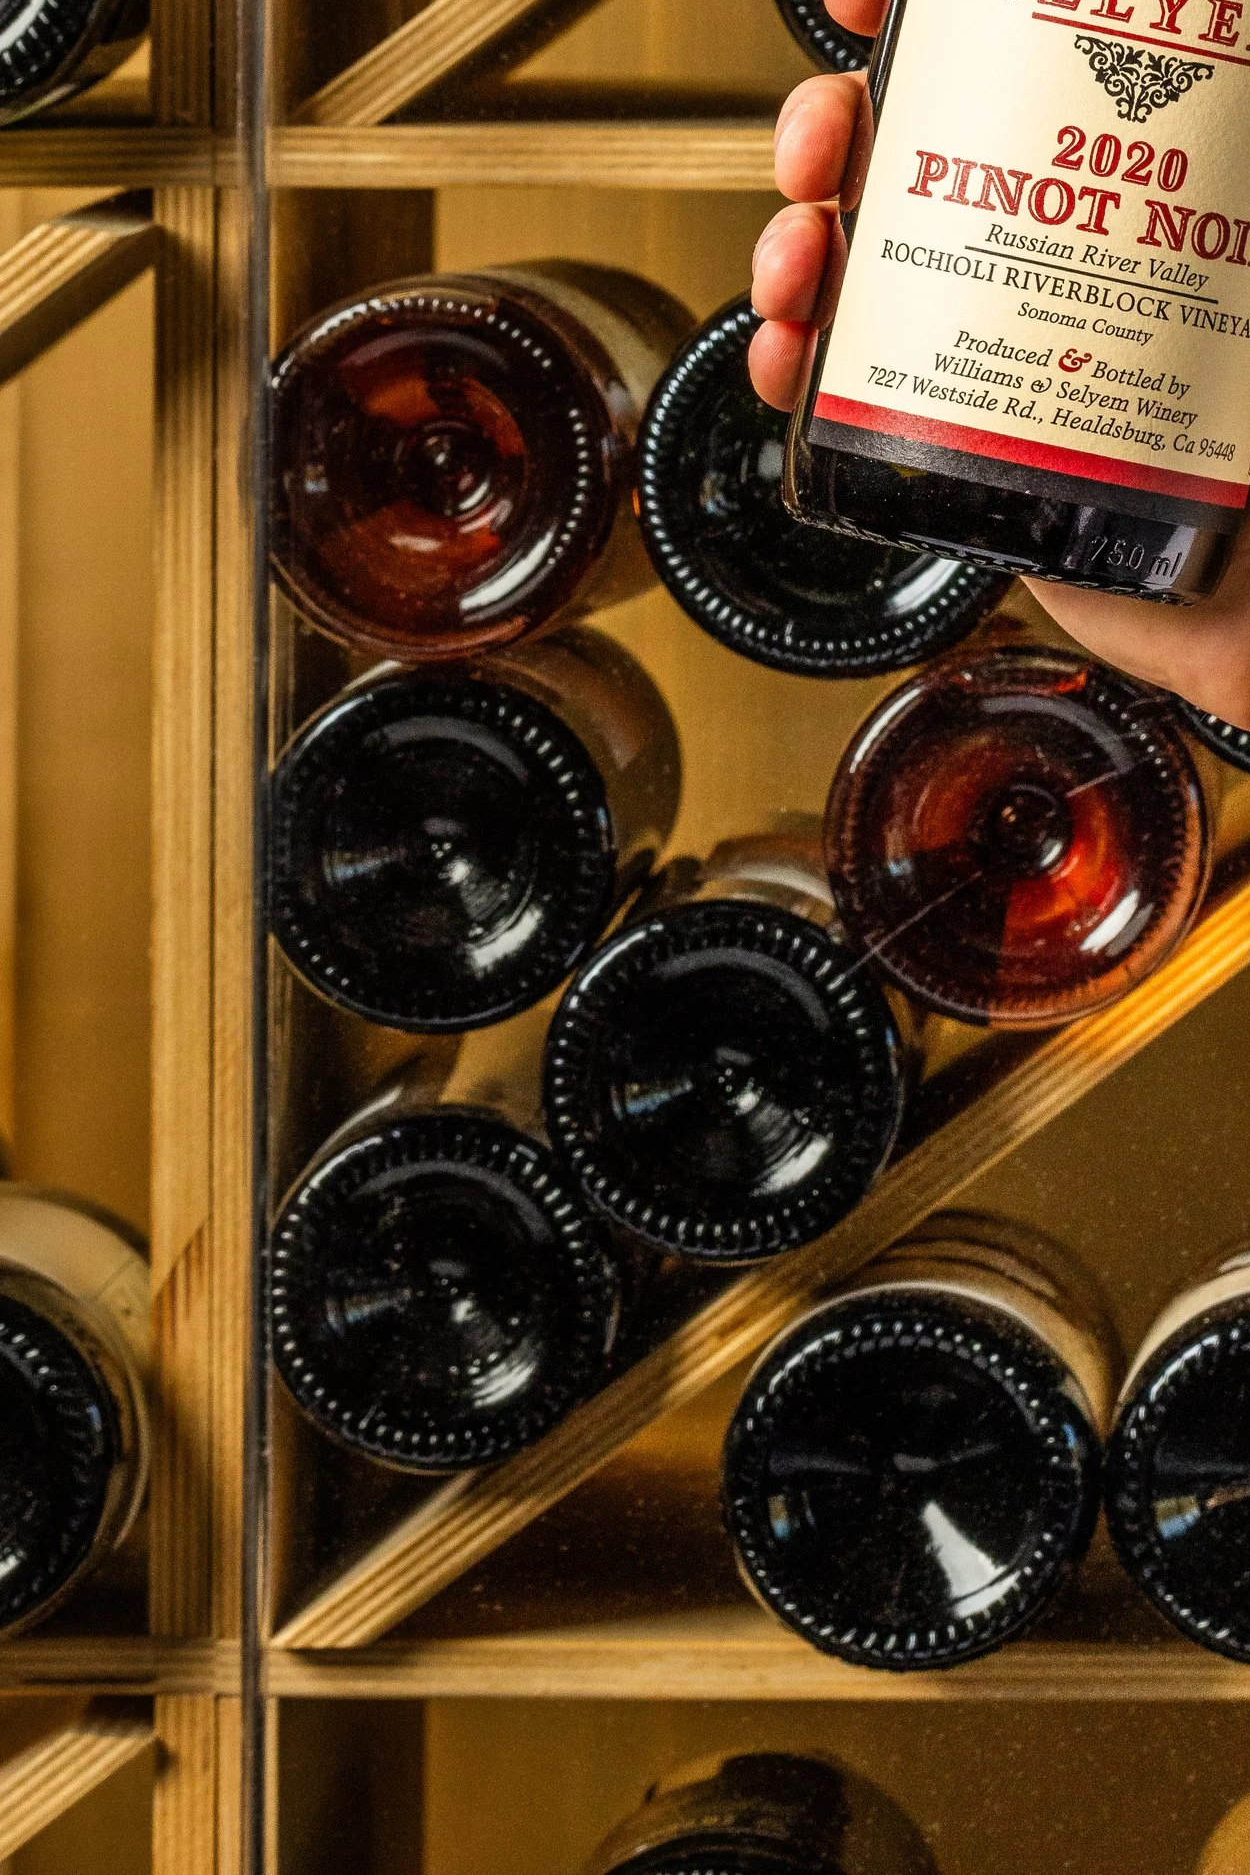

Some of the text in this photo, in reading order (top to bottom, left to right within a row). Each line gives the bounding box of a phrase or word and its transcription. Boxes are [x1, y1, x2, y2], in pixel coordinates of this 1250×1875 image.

[907, 150, 1122, 236] PINOT
[1052, 125, 1188, 192] 2020
[881, 239, 998, 282] ROCHIOLI
[1002, 266, 1172, 321] RIVERBLOCK
[985, 223, 1209, 292] Russian River Valley
[1018, 301, 1153, 346] Sonoma County
[934, 353, 1198, 429] Williams & Selyem Winery
[953, 330, 1191, 400] Produced & Bottled by
[867, 365, 1236, 462] 7227 Westside Rd., Healdsburg, Ca 95448
[1147, 551, 1182, 579] ml
